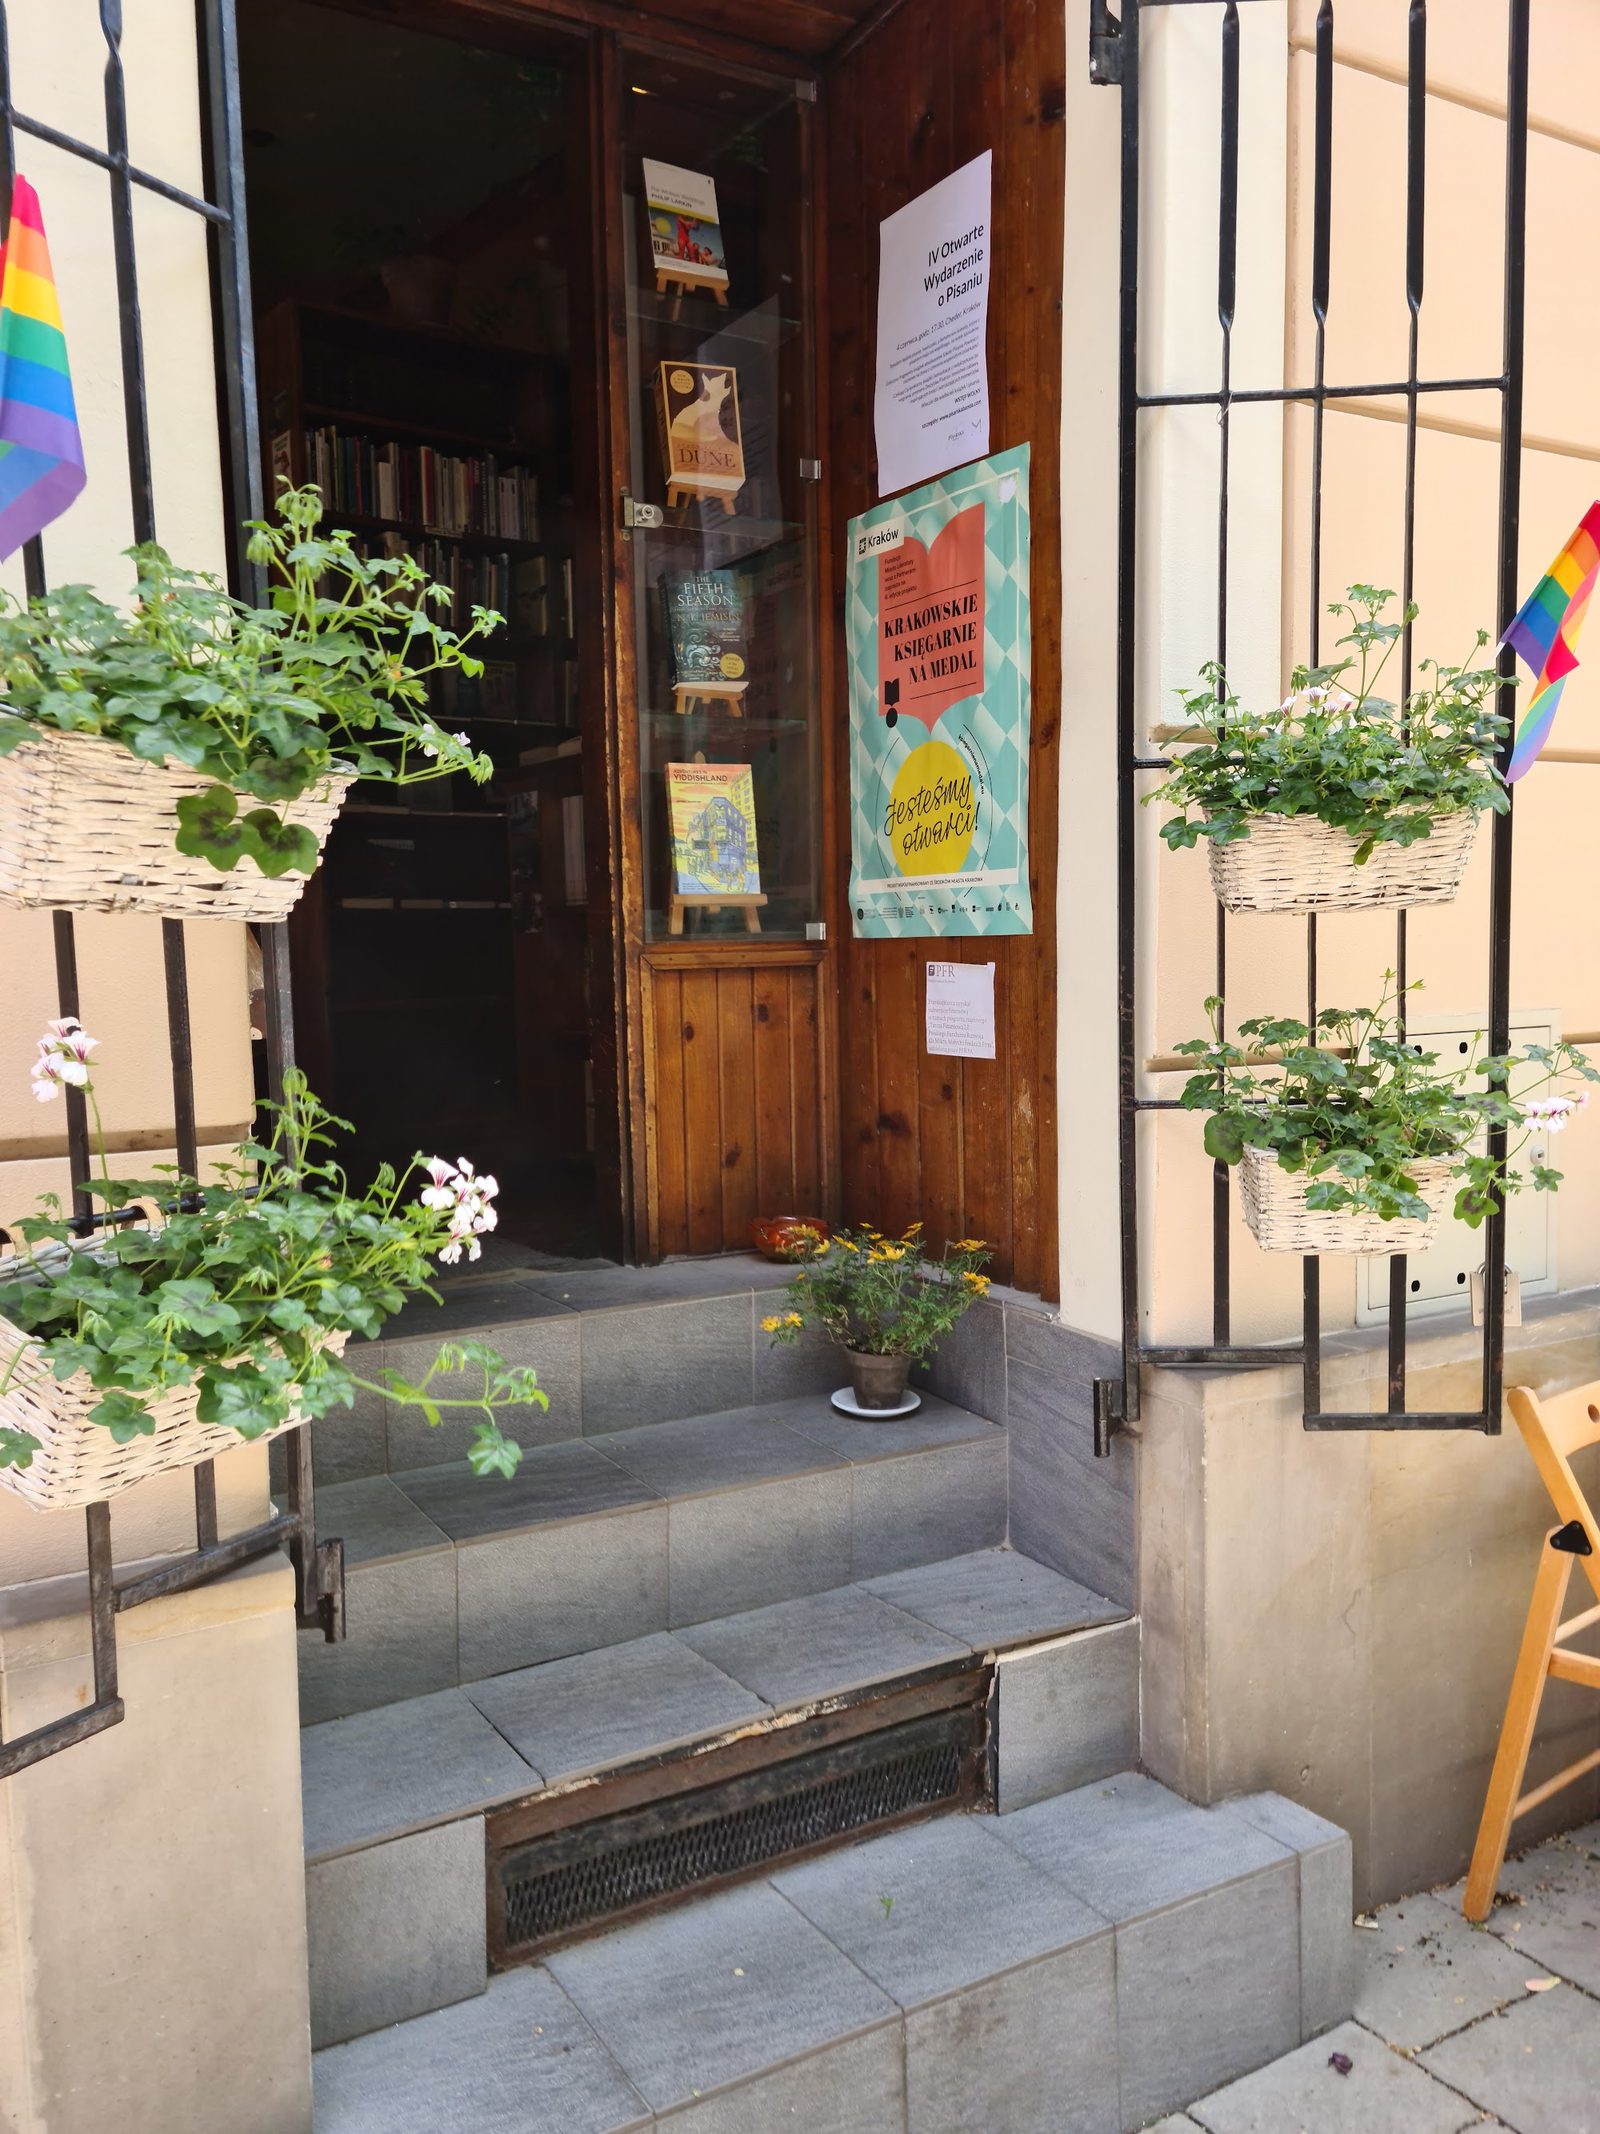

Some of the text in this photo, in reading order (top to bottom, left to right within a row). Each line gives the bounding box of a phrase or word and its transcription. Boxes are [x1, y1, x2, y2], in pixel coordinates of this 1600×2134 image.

[928, 224, 984, 267] IV Otwarte
[924, 248, 984, 292] Wydarzenie
[938, 272, 983, 307] o Pisaniu
[680, 448, 736, 468] DUNE
[868, 528, 899, 549] Kraków
[677, 594, 734, 607] SEASON
[683, 582, 724, 594] FIFTH
[701, 612, 741, 621] JEMISIN
[885, 593, 978, 638] KRAKOWSKIE
[894, 622, 977, 662] KSIĘGARNIE
[910, 650, 977, 685] NA MEDAL
[673, 773, 728, 782] YIDDISHLAND
[884, 775, 972, 837] Jesteśmy
[902, 801, 981, 856] otwarci!
[936, 965, 955, 977] PFR
